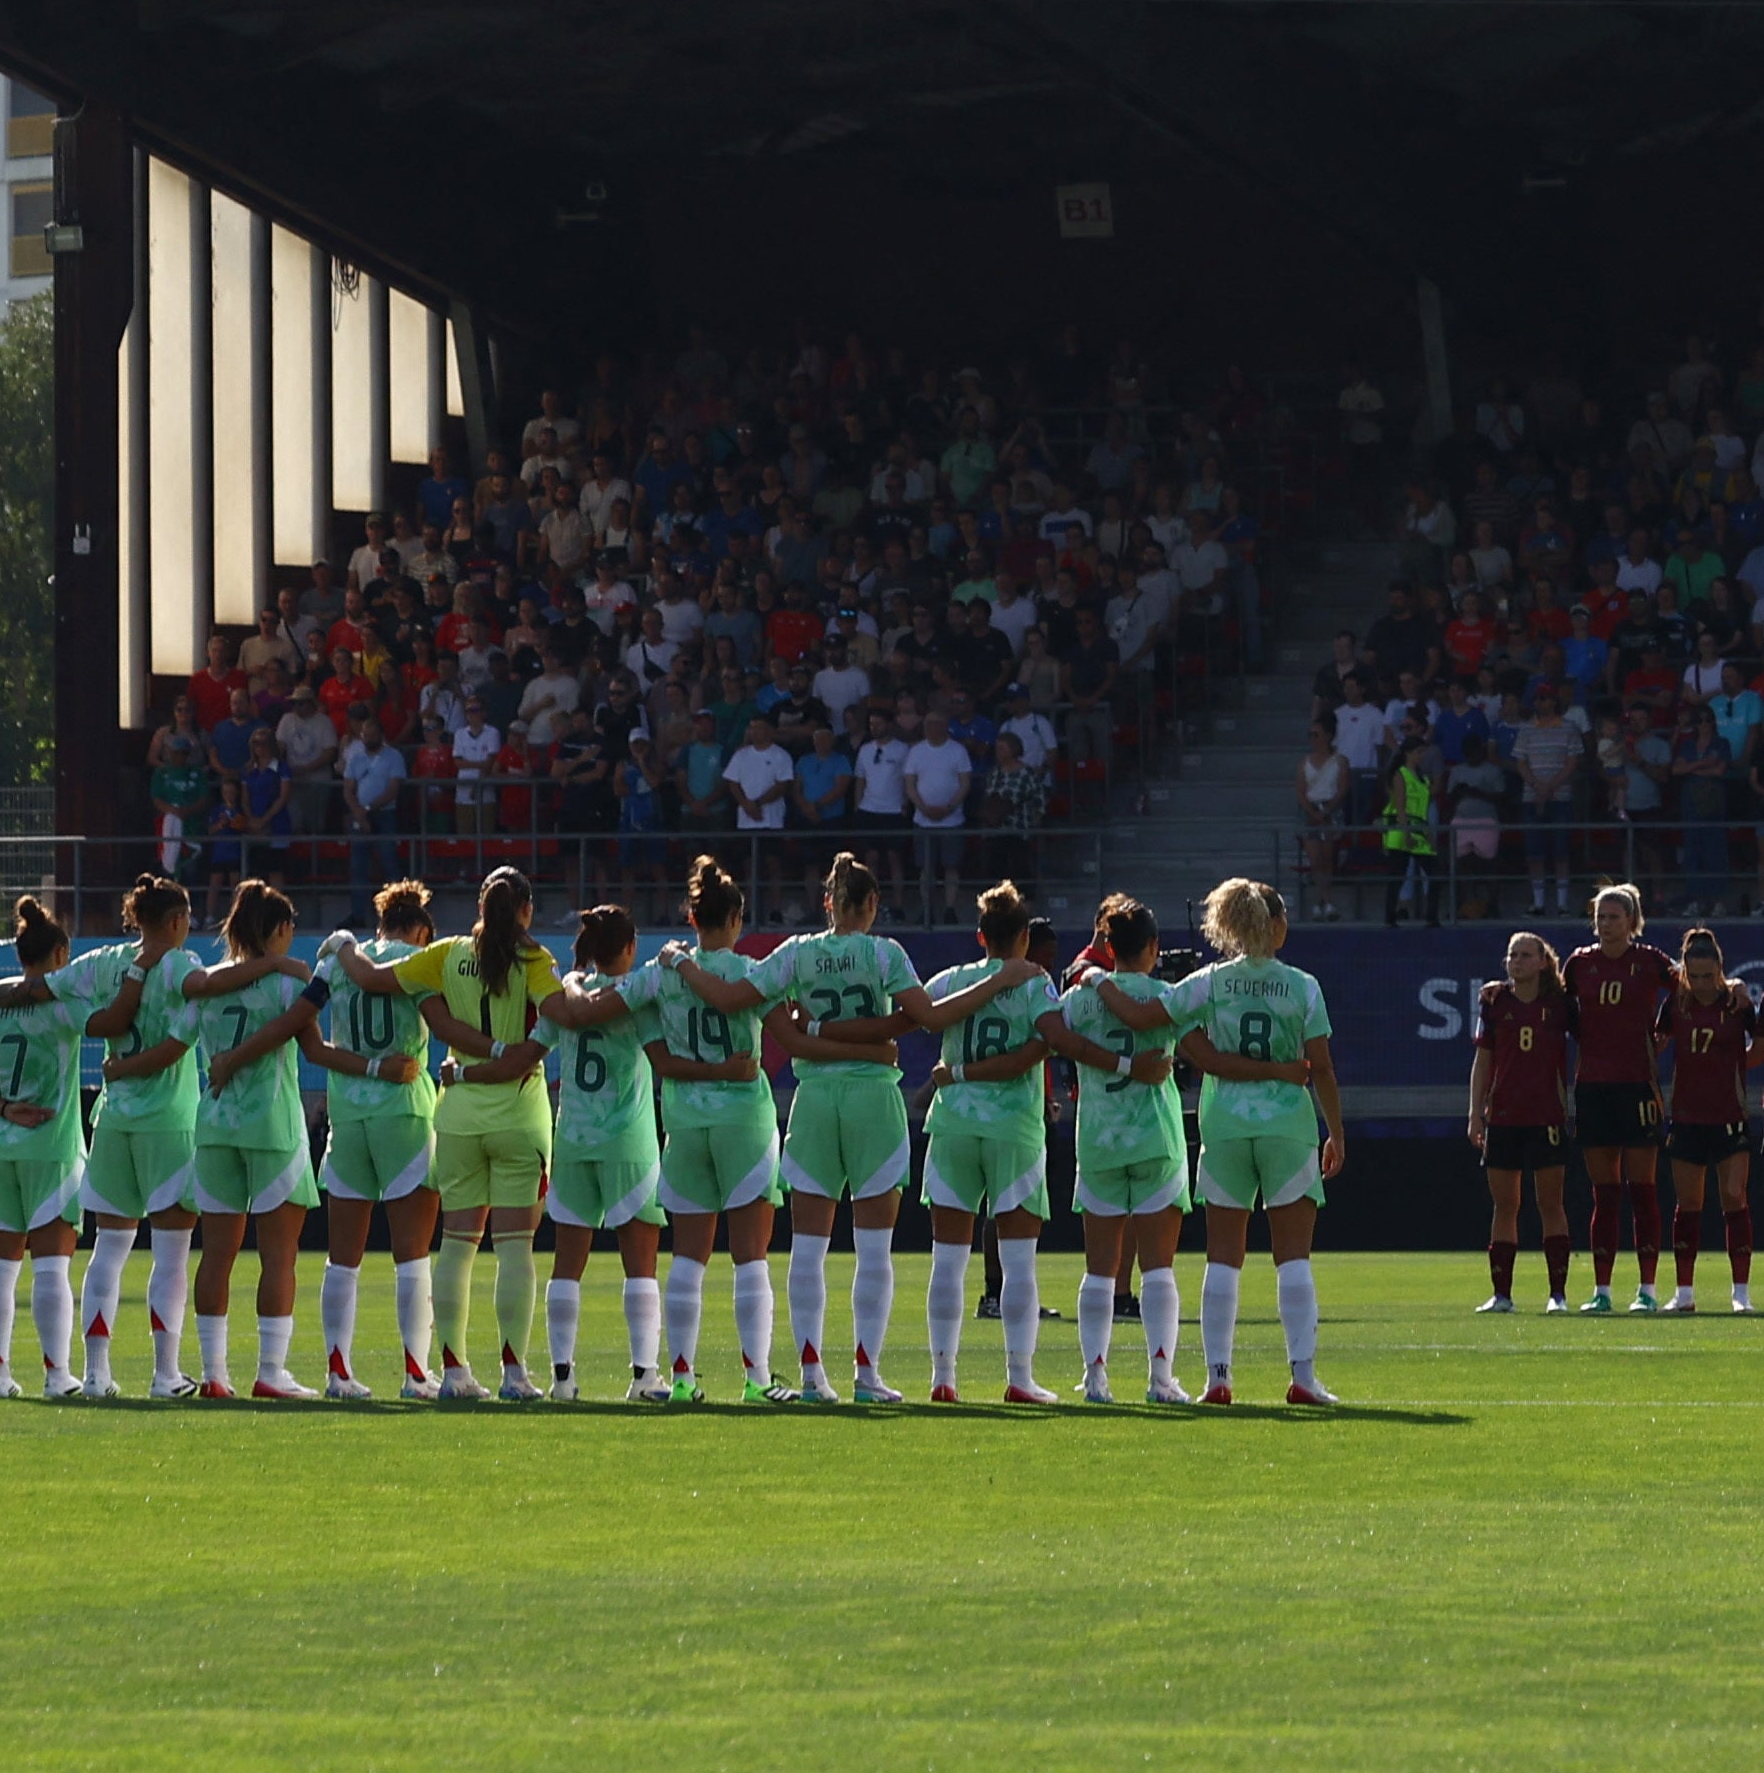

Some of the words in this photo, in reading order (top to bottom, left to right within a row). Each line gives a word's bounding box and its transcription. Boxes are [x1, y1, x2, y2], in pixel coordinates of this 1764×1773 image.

[1064, 198, 1105, 222] B1
[815, 956, 856, 975] SALVAI
[1225, 979, 1290, 998] SEVERINI
[1598, 981, 1623, 1006] 10
[222, 1006, 249, 1054] 7
[348, 993, 395, 1052] 10
[688, 1006, 734, 1064] 19
[962, 1014, 1010, 1064] 18
[1238, 1012, 1272, 1062] 8
[1518, 1026, 1534, 1052] 8
[1690, 1027, 1715, 1054] 17
[575, 1030, 607, 1093] 6
[1638, 1100, 1658, 1127] 10
